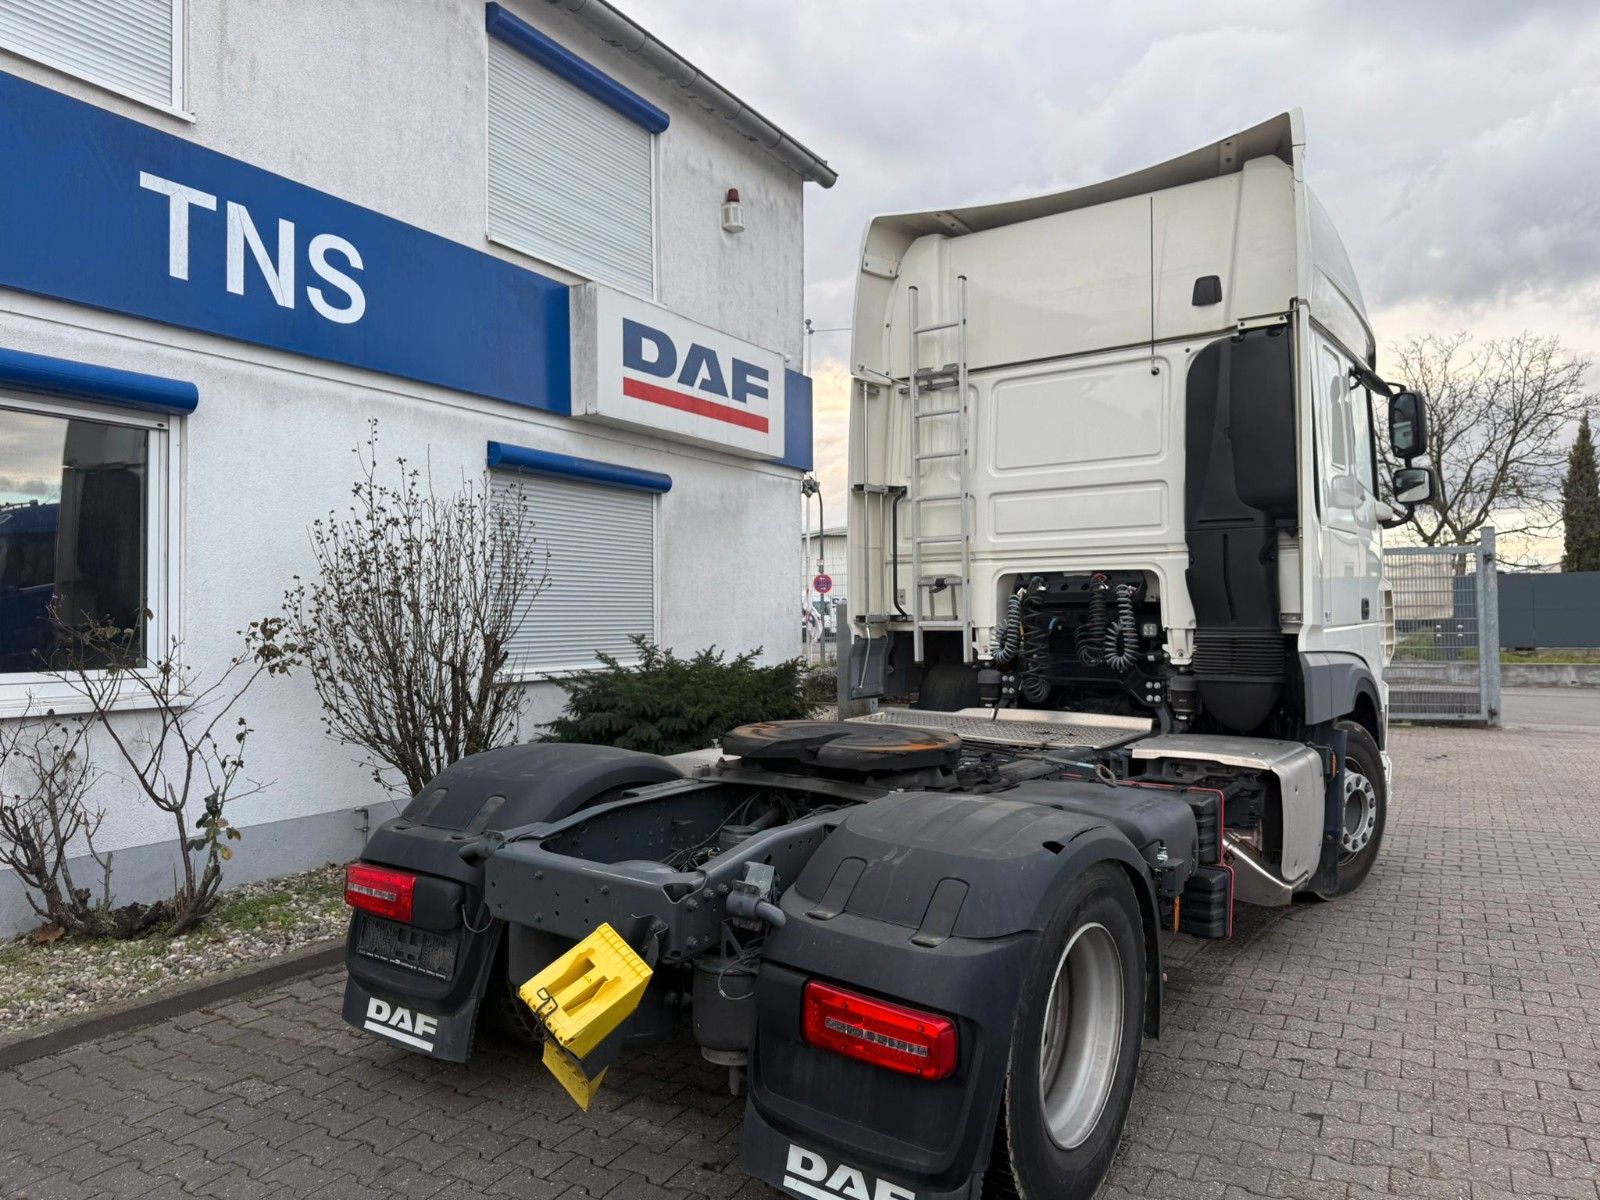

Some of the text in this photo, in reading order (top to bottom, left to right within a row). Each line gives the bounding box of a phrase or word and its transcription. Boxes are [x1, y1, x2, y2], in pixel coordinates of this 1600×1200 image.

[140, 170, 366, 324] TNS
[623, 317, 769, 404] DAF
[366, 997, 438, 1036] DAF
[786, 1144, 916, 1200] DAF
